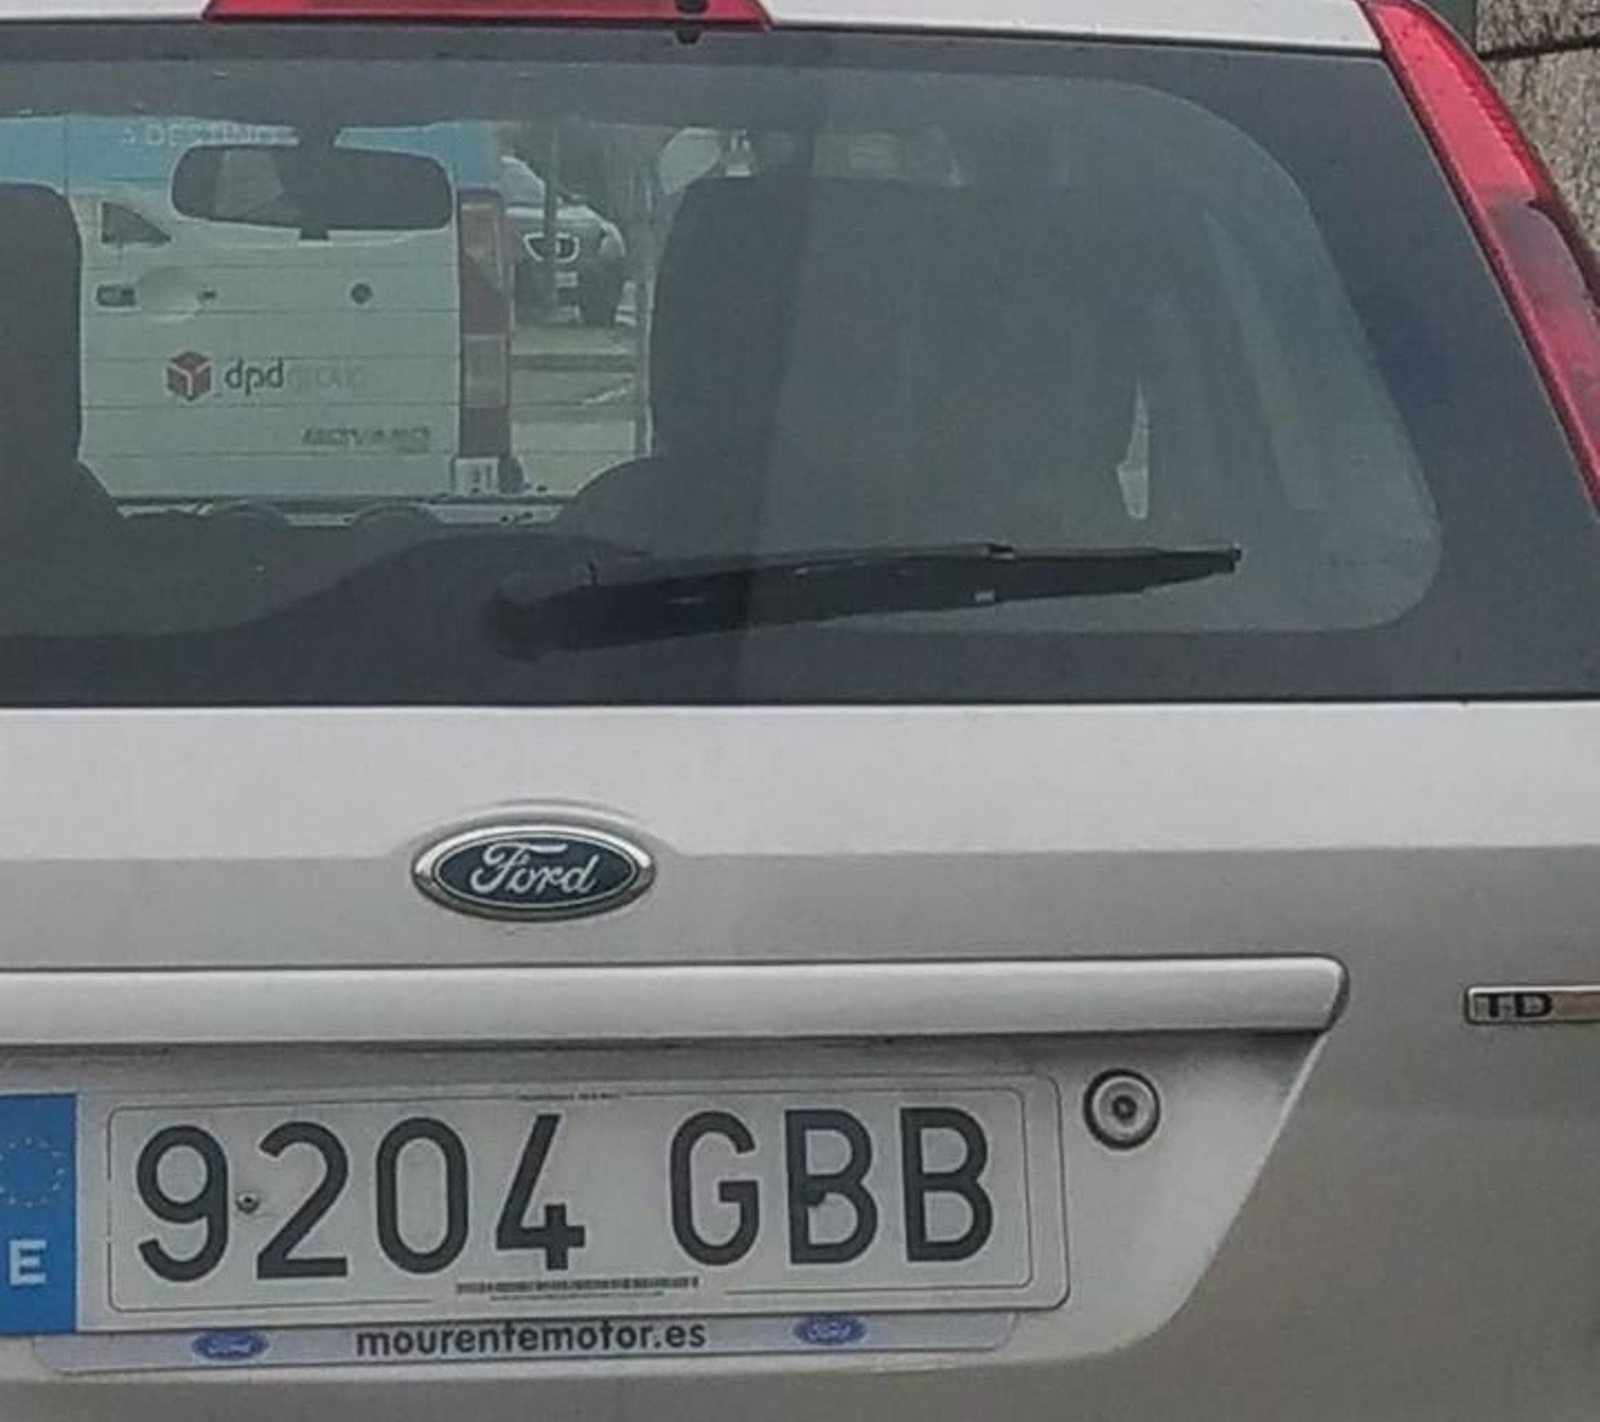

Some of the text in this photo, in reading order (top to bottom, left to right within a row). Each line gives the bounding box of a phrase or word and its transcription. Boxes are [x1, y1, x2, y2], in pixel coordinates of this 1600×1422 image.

[469, 842, 599, 895] Ford
[136, 1106, 994, 1283] 9204 GBB
[9, 1238, 47, 1287] E
[356, 1319, 708, 1358] mourentemotor.es
